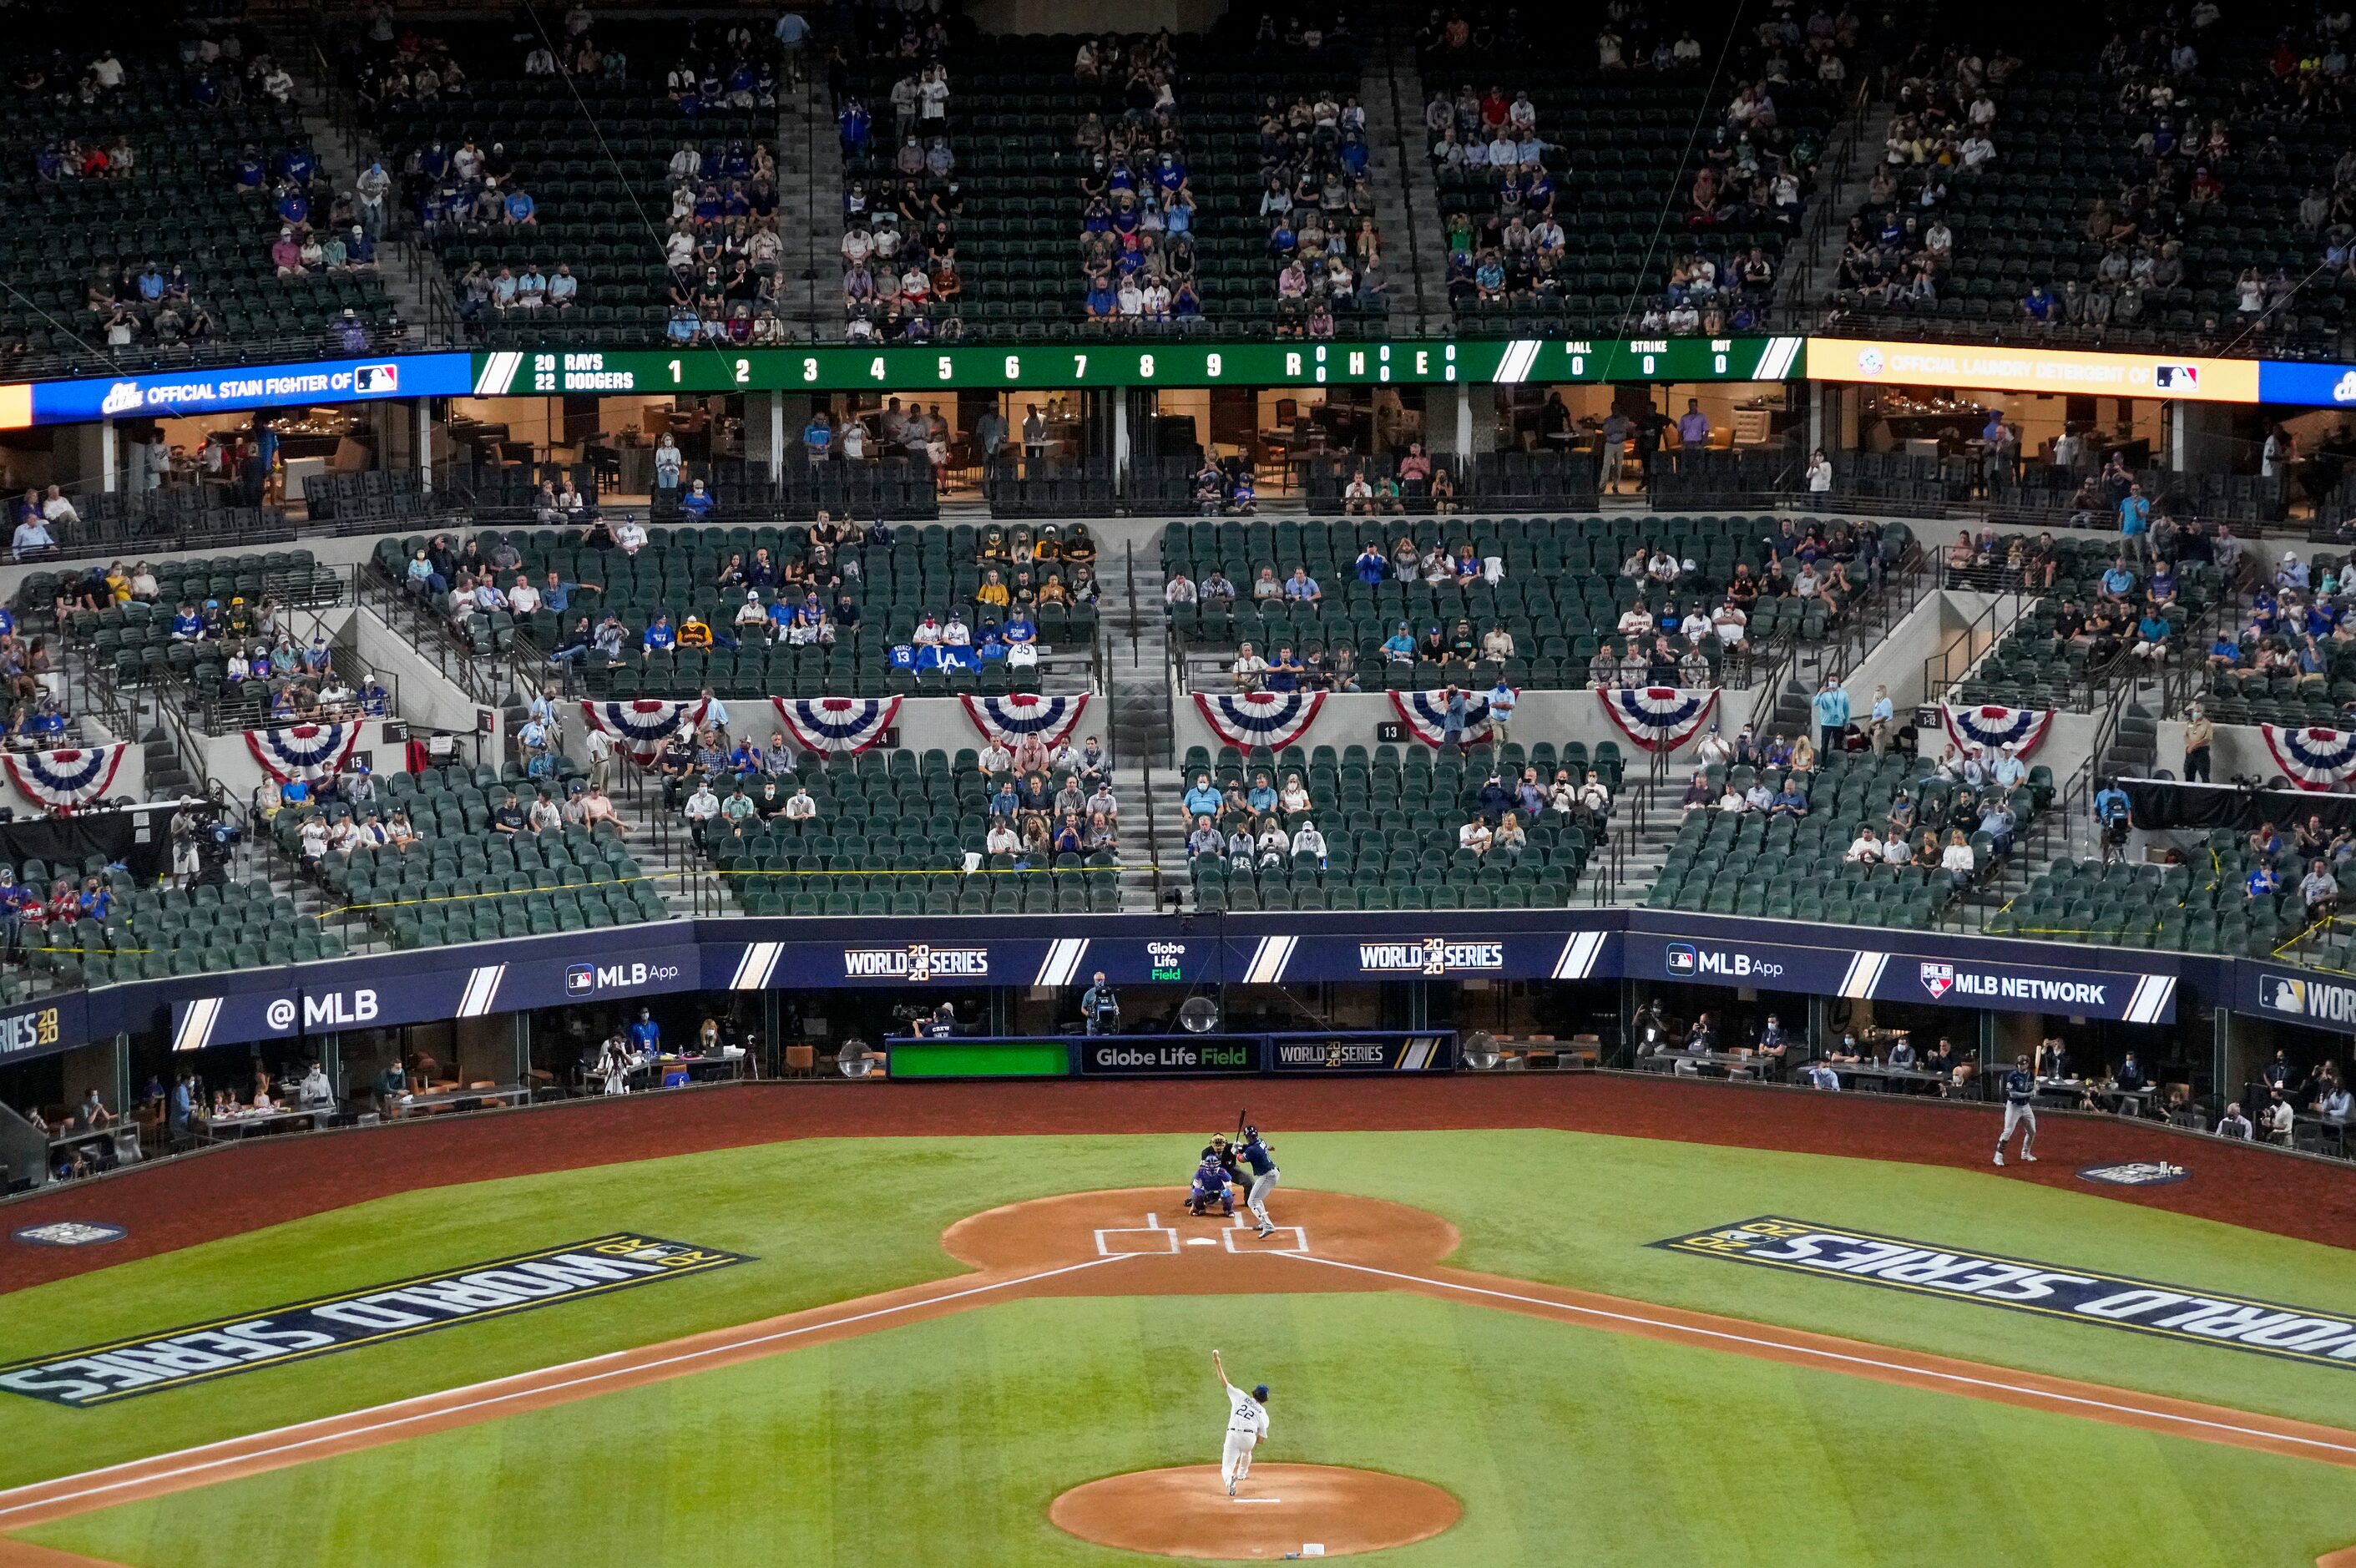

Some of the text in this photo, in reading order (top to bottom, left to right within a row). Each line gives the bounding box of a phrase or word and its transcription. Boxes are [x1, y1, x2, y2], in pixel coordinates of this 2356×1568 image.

[1316, 346, 1327, 362] 0
[1379, 345, 1390, 362] 0
[1445, 344, 1455, 361] 0
[1566, 341, 1592, 354] BALL
[1630, 341, 1667, 353] STRIKE
[1711, 340, 1731, 352] OUT
[534, 353, 603, 371] 20 RAYS
[668, 360, 680, 382] 1
[736, 359, 750, 382] 2
[804, 358, 817, 381] 3
[870, 357, 885, 380] 4
[938, 357, 953, 379] 5
[1005, 356, 1019, 378] 6
[1074, 355, 1087, 378] 7
[1140, 354, 1154, 377] 8
[1207, 353, 1221, 376] 9
[1287, 353, 1301, 375] R
[1349, 352, 1364, 374] H
[1417, 351, 1428, 373] E
[1572, 357, 1583, 376] 0
[1643, 355, 1654, 374] 0
[1715, 354, 1726, 373] 0
[1890, 355, 2150, 382] OFFICIAL LAUNDRY DETERGENT OF
[535, 372, 633, 390] 22 DODGERS
[1316, 366, 1327, 382] 0
[1379, 365, 1390, 382] 0
[1445, 364, 1455, 381] 0
[147, 372, 352, 404] OFFICIAL STAIN FIGHTER OF
[896, 651, 910, 662] 13
[1016, 644, 1030, 655] 35
[400, 731, 407, 740] 15
[1384, 726, 1398, 738] 13
[351, 756, 362, 769] 15
[908, 944, 929, 957] 20
[1147, 942, 1186, 955] Globe
[1423, 938, 1444, 951] 20
[845, 950, 988, 975] WORLD SERIES
[1154, 954, 1178, 967] Life
[1360, 944, 1503, 969] WORLD SERIES
[1699, 951, 1783, 976] MLB App
[597, 963, 678, 989] MLB App
[908, 969, 929, 981] 20
[1152, 967, 1181, 981] Field
[1423, 962, 1444, 975] 20
[1924, 965, 1951, 977] MLB
[1955, 974, 2105, 1004] MLB NETWORK
[38, 1008, 58, 1028] 20
[38, 1026, 58, 1045] 20
[1096, 1047, 1246, 1066] Globe Life Field
[1280, 1046, 1383, 1063] WORLD SERIES
[1745, 1234, 2098, 1301] SERIES
[2, 1252, 669, 1399] WORLD SERIES
[1236, 1404, 1255, 1420] 22
